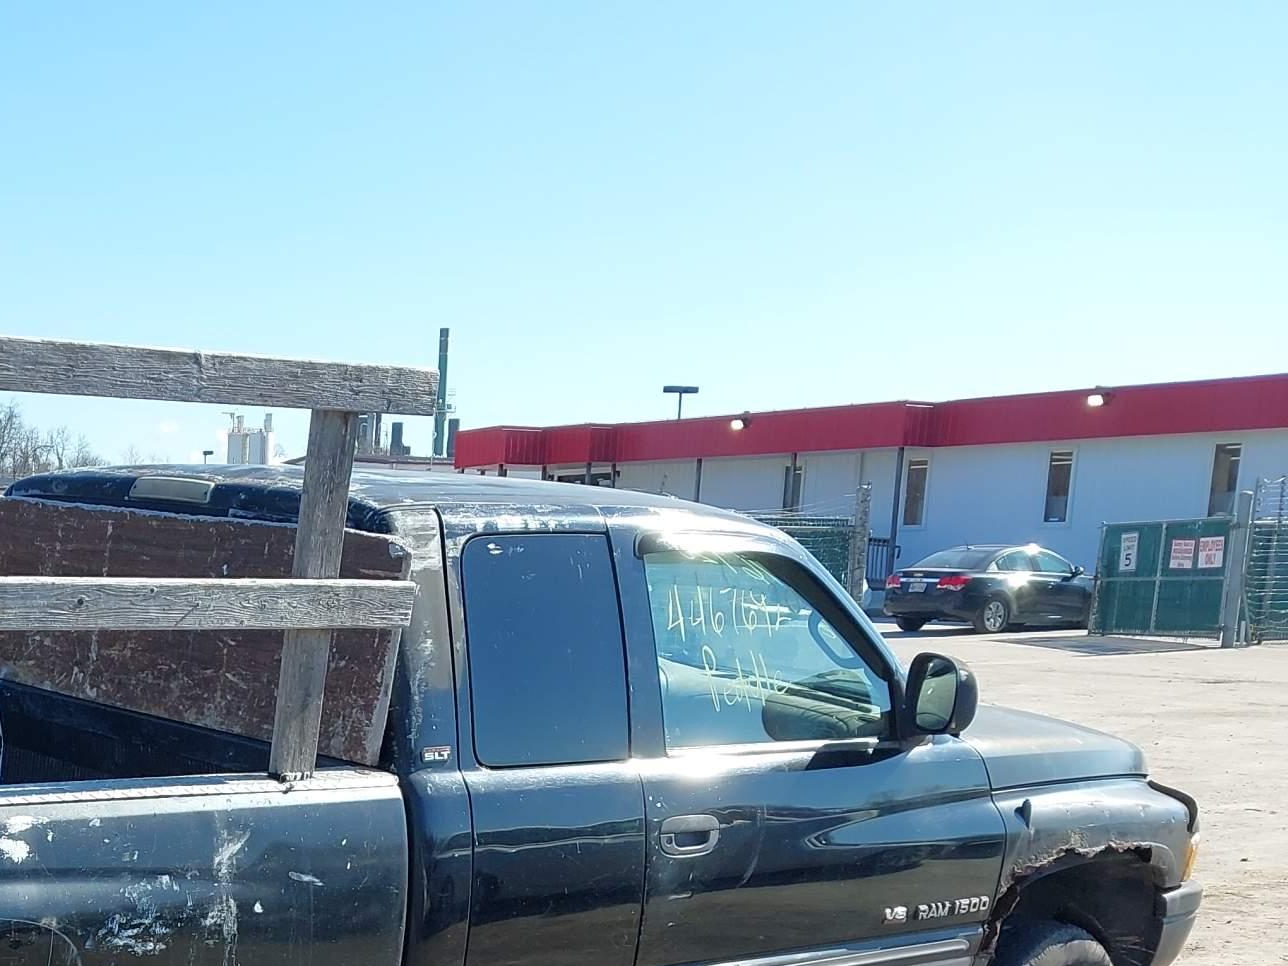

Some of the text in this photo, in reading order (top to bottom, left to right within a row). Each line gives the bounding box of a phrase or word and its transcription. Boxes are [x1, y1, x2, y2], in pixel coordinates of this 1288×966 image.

[1124, 553, 1132, 567] 5
[424, 751, 451, 761] SLT
[918, 896, 990, 920] RAM 1500
